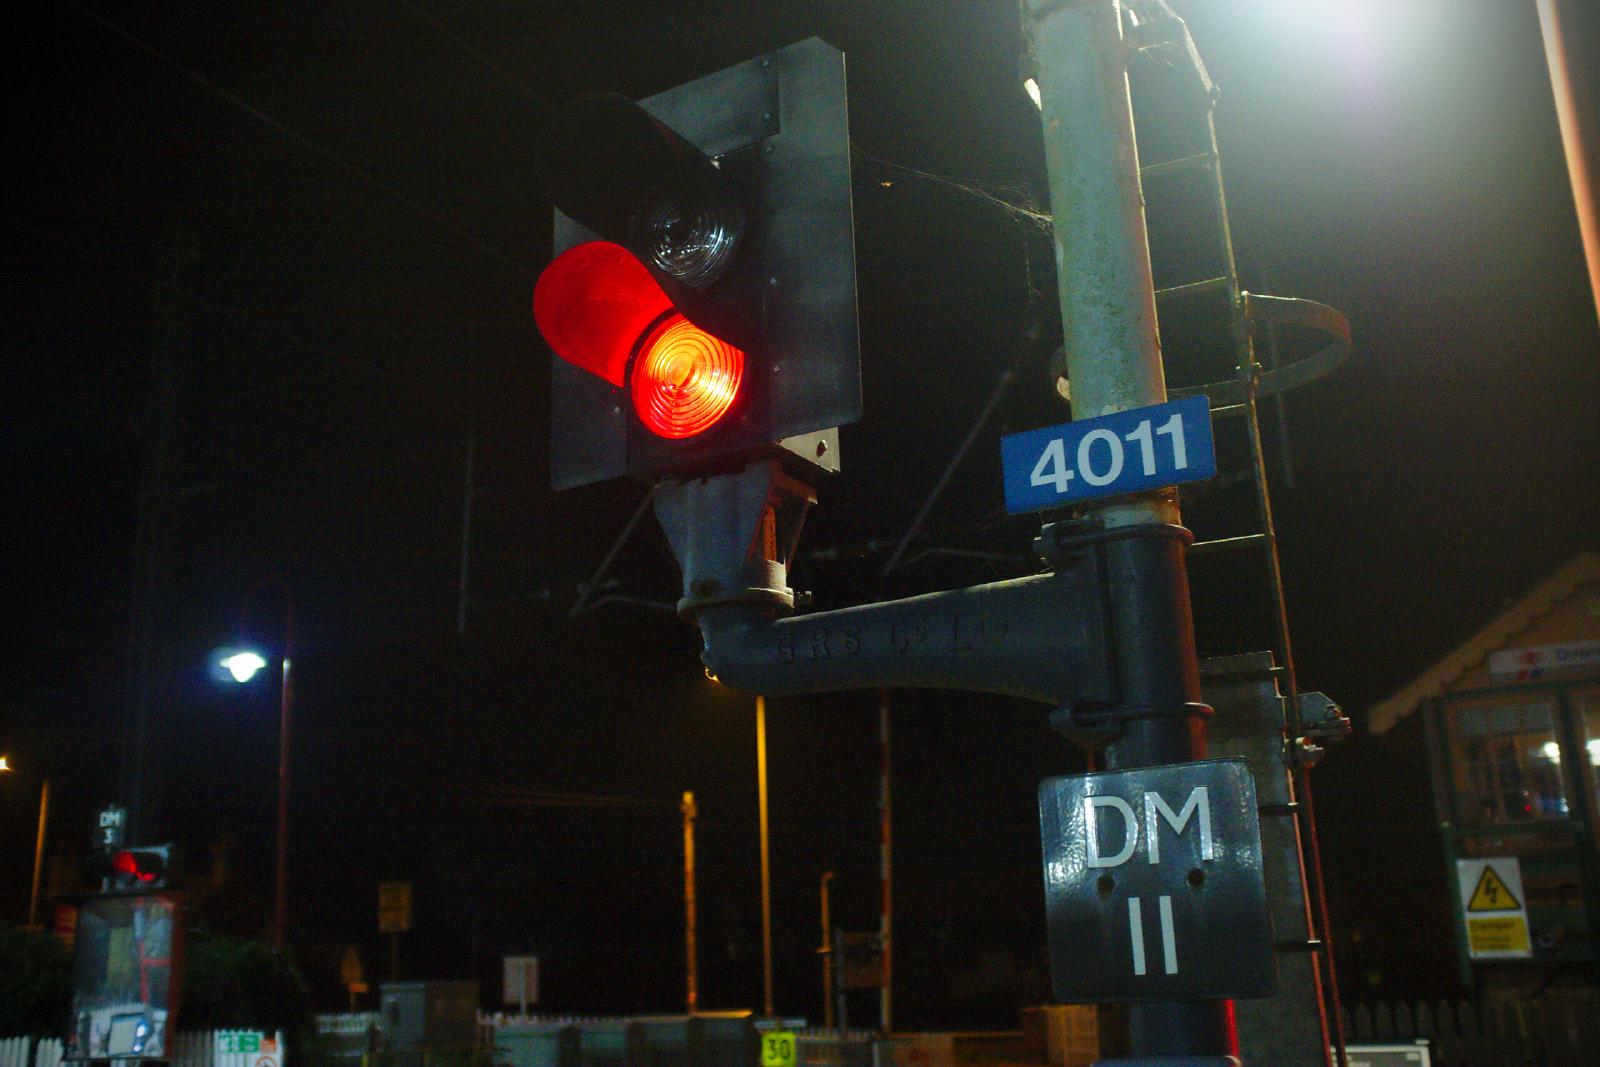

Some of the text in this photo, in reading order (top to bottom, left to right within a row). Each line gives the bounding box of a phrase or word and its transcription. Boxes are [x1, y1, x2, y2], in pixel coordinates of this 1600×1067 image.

[1031, 413, 1188, 493] 4011
[99, 811, 120, 827] DM
[1084, 786, 1214, 868] DM
[768, 1039, 792, 1061] 30
